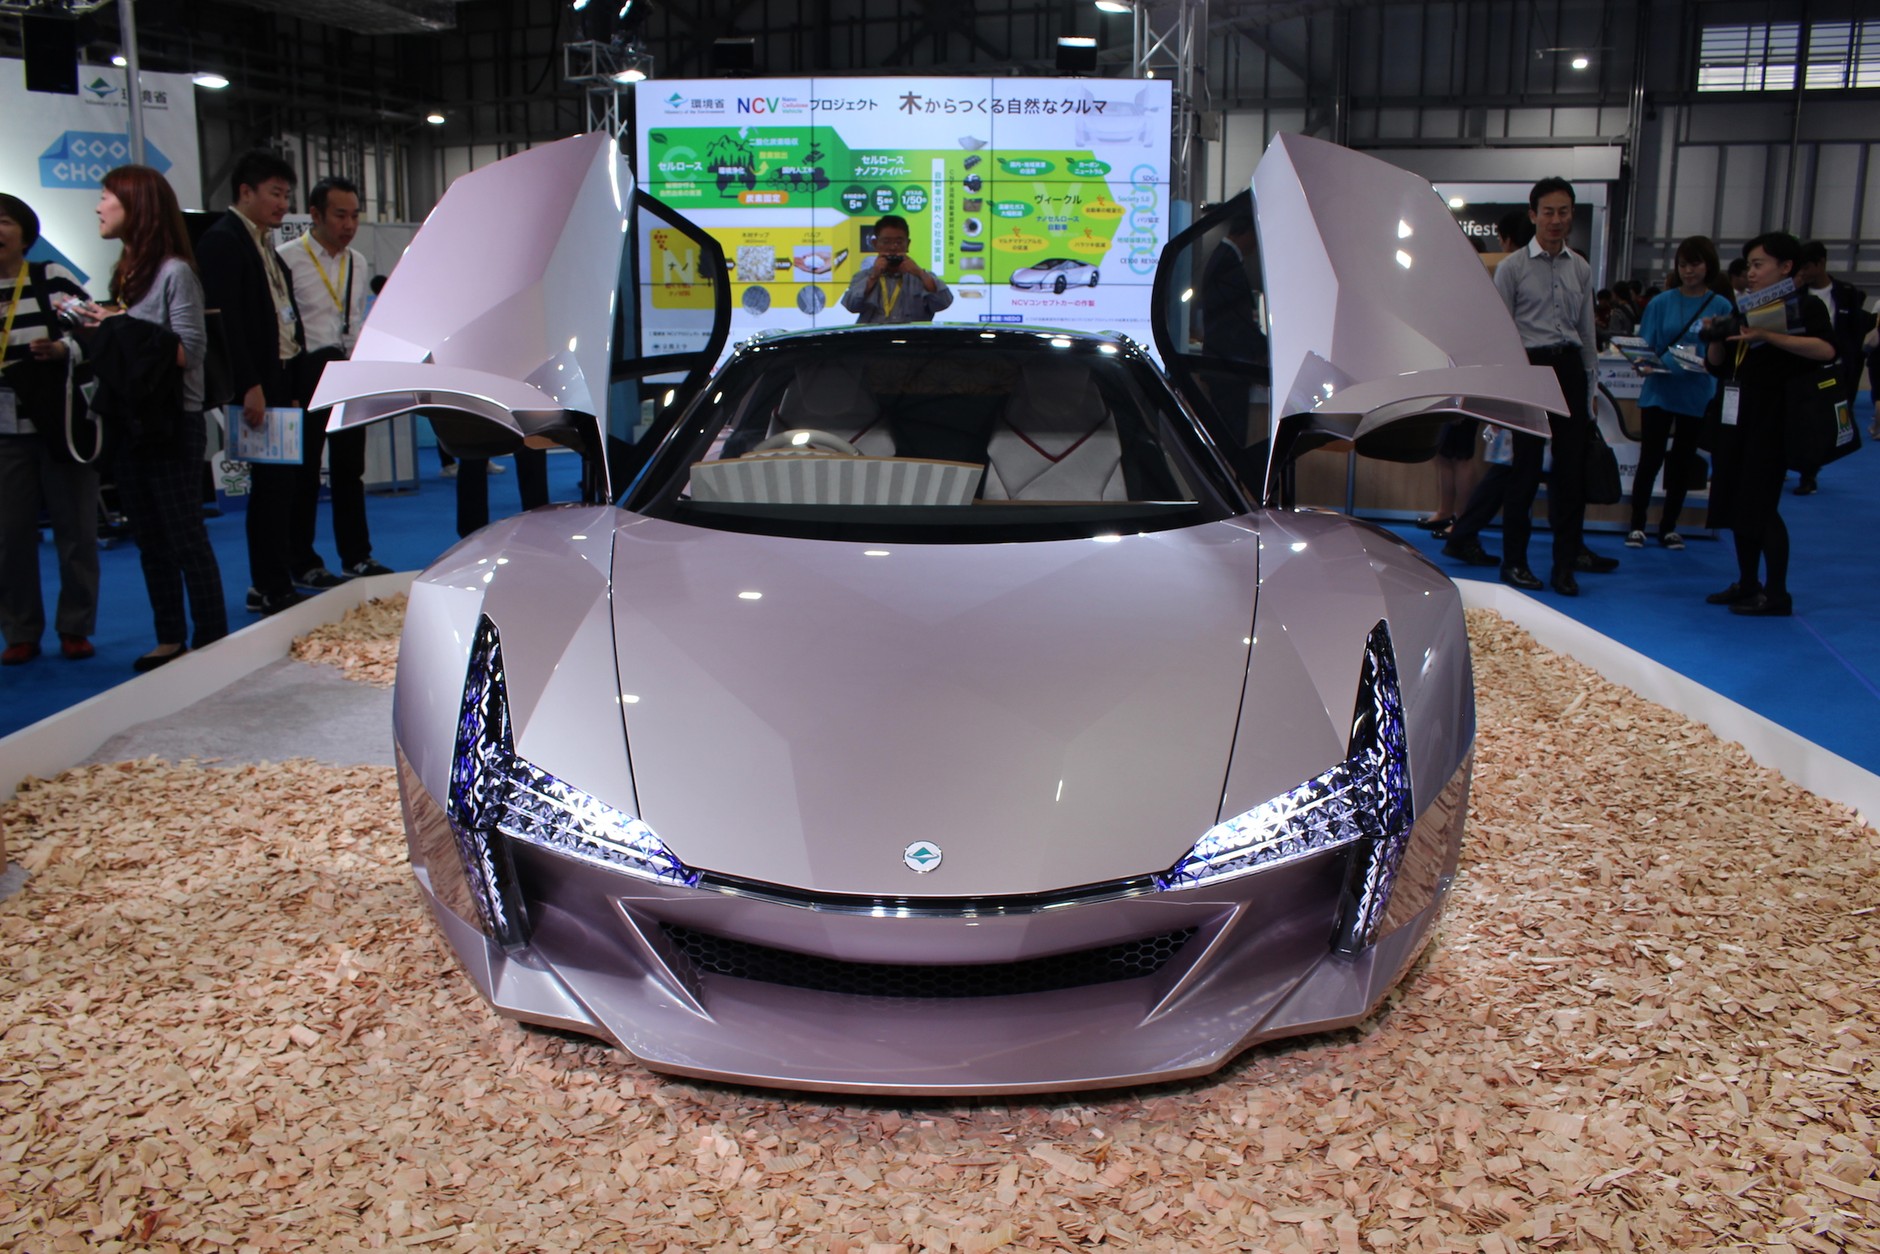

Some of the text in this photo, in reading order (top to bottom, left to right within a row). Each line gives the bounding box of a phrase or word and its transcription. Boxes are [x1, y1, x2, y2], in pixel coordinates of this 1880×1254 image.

[691, 98, 725, 109] 環境省
[737, 97, 878, 114] NCV プロジェクト
[899, 91, 1108, 116] 木からつくる自然なクルマ
[861, 155, 905, 165] セルロース
[657, 161, 703, 171] セルロース
[854, 166, 912, 177] ナノファイバー
[1034, 194, 1082, 205] ヴィークル
[1117, 196, 1139, 204] Society
[1036, 215, 1080, 223] ナノセルロース
